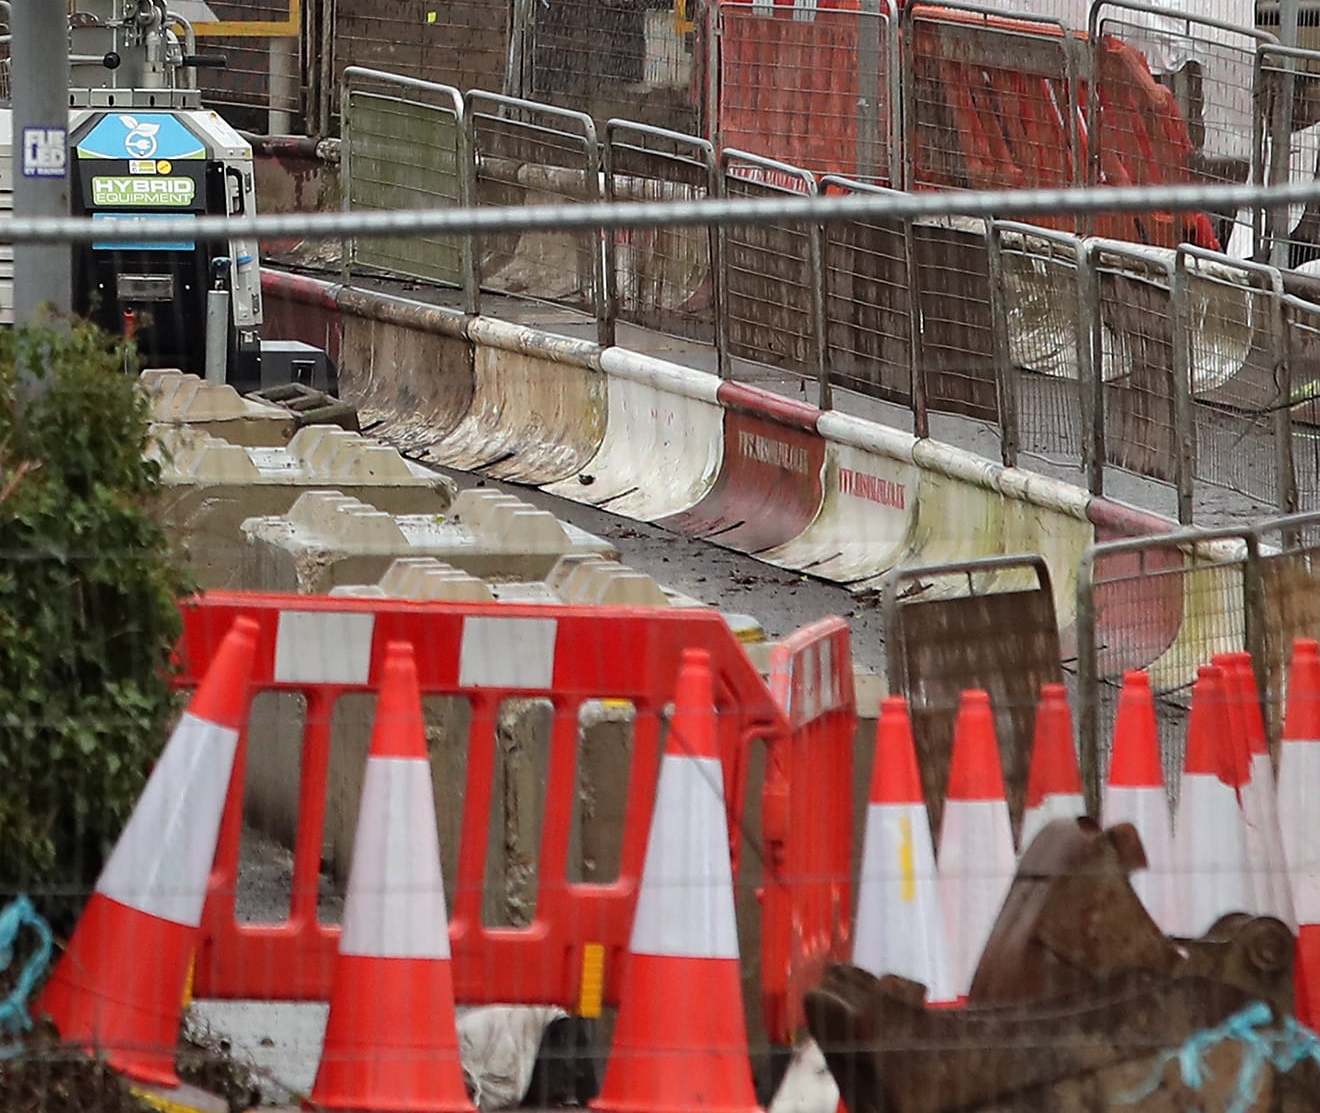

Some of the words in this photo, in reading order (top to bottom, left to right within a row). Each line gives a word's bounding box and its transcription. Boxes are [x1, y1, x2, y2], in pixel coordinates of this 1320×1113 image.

[24, 148, 65, 167] LED
[95, 179, 192, 193] HYBRID
[96, 193, 191, 203] EQUIPMENT
